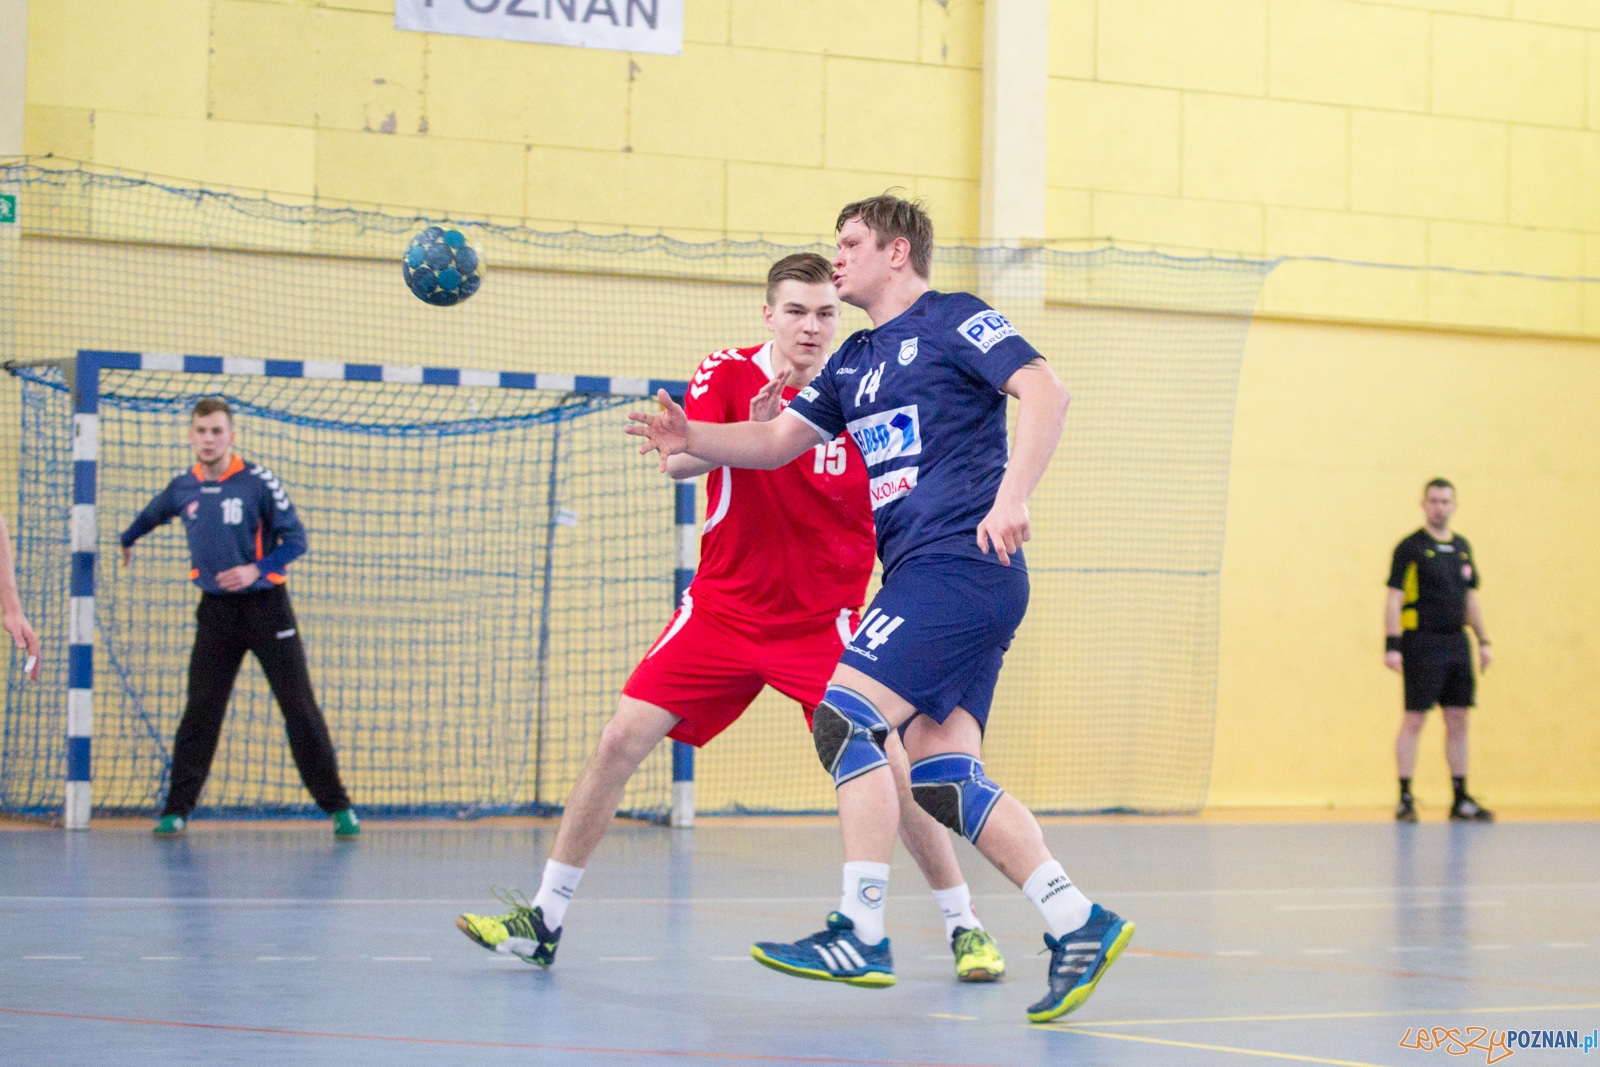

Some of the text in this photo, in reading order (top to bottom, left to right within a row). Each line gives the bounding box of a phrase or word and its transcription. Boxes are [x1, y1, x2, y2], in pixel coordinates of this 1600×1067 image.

[855, 361, 886, 407] 14
[813, 437, 847, 475] 15
[220, 497, 243, 525] 16
[851, 608, 905, 650] 14
